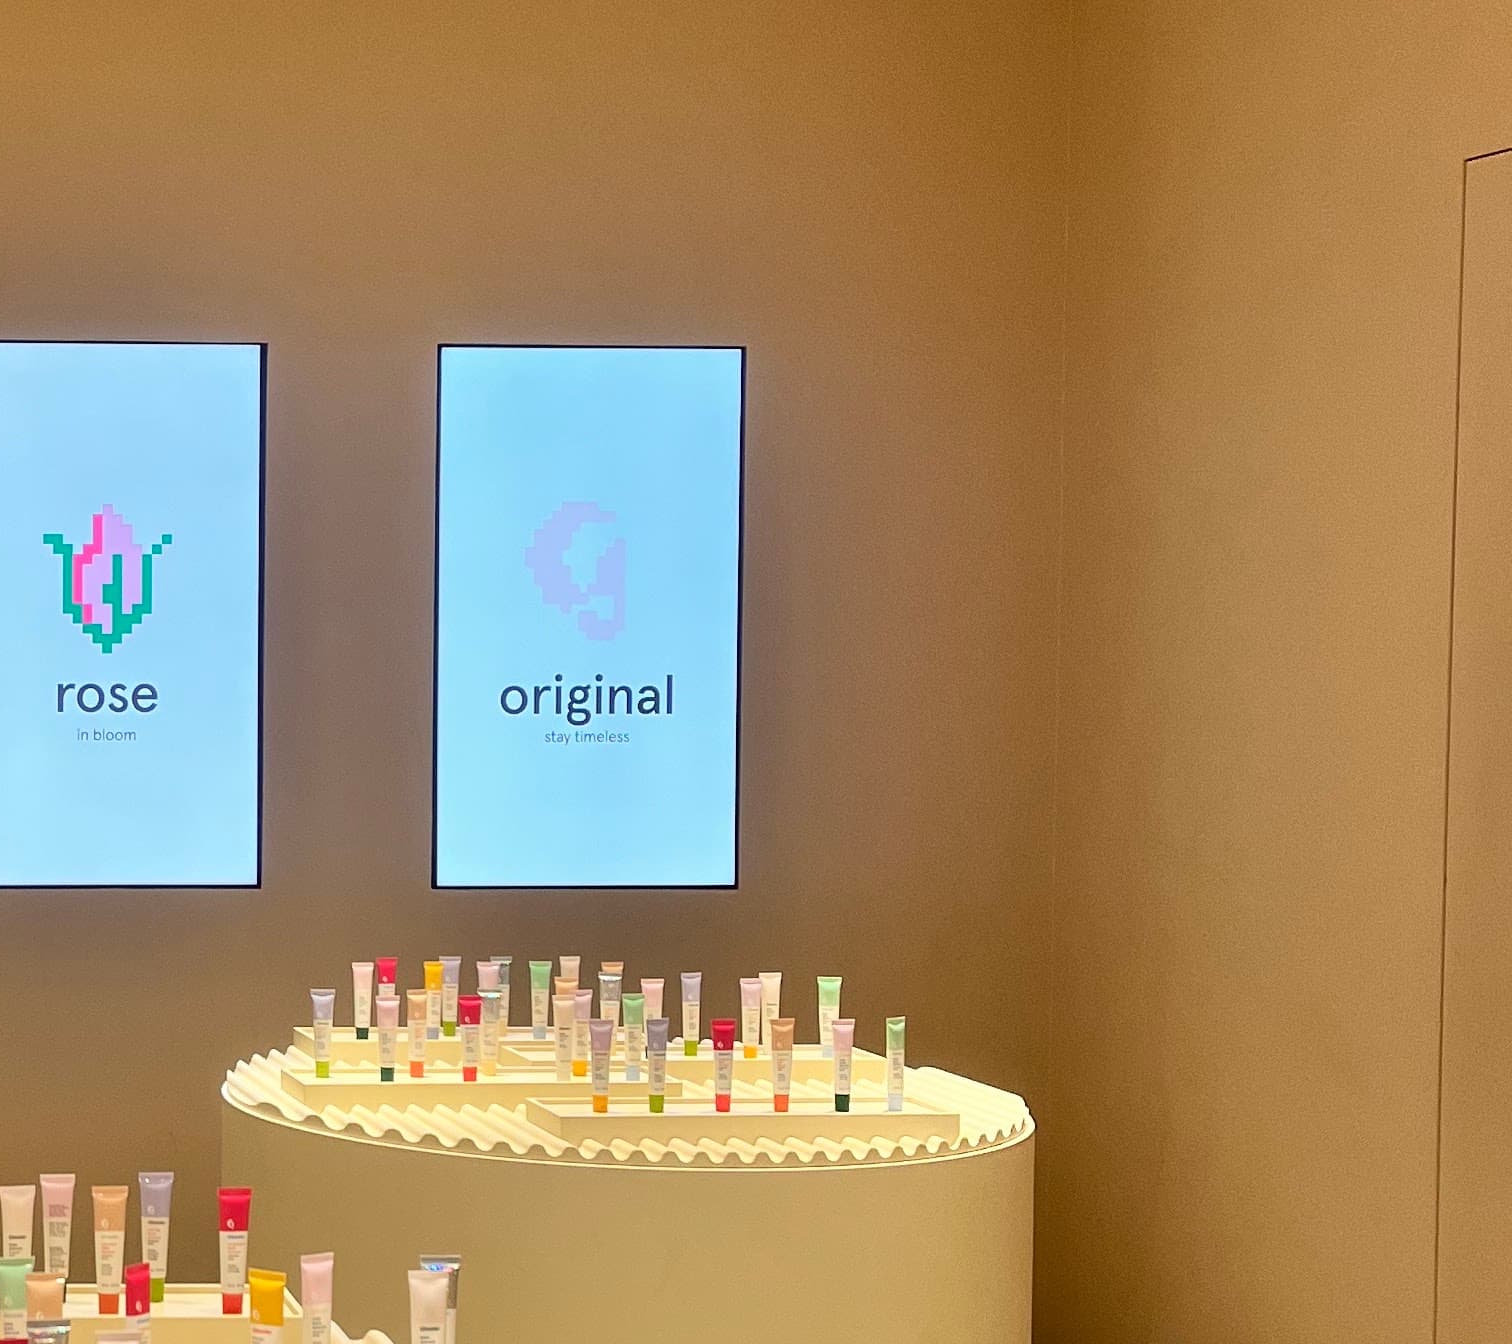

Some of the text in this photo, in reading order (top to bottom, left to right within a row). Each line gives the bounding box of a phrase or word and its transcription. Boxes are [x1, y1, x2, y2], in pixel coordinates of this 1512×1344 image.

[56, 683, 158, 713] rose
[500, 674, 673, 726] original
[77, 728, 137, 741] in bloom
[544, 730, 630, 745] stay timeless
